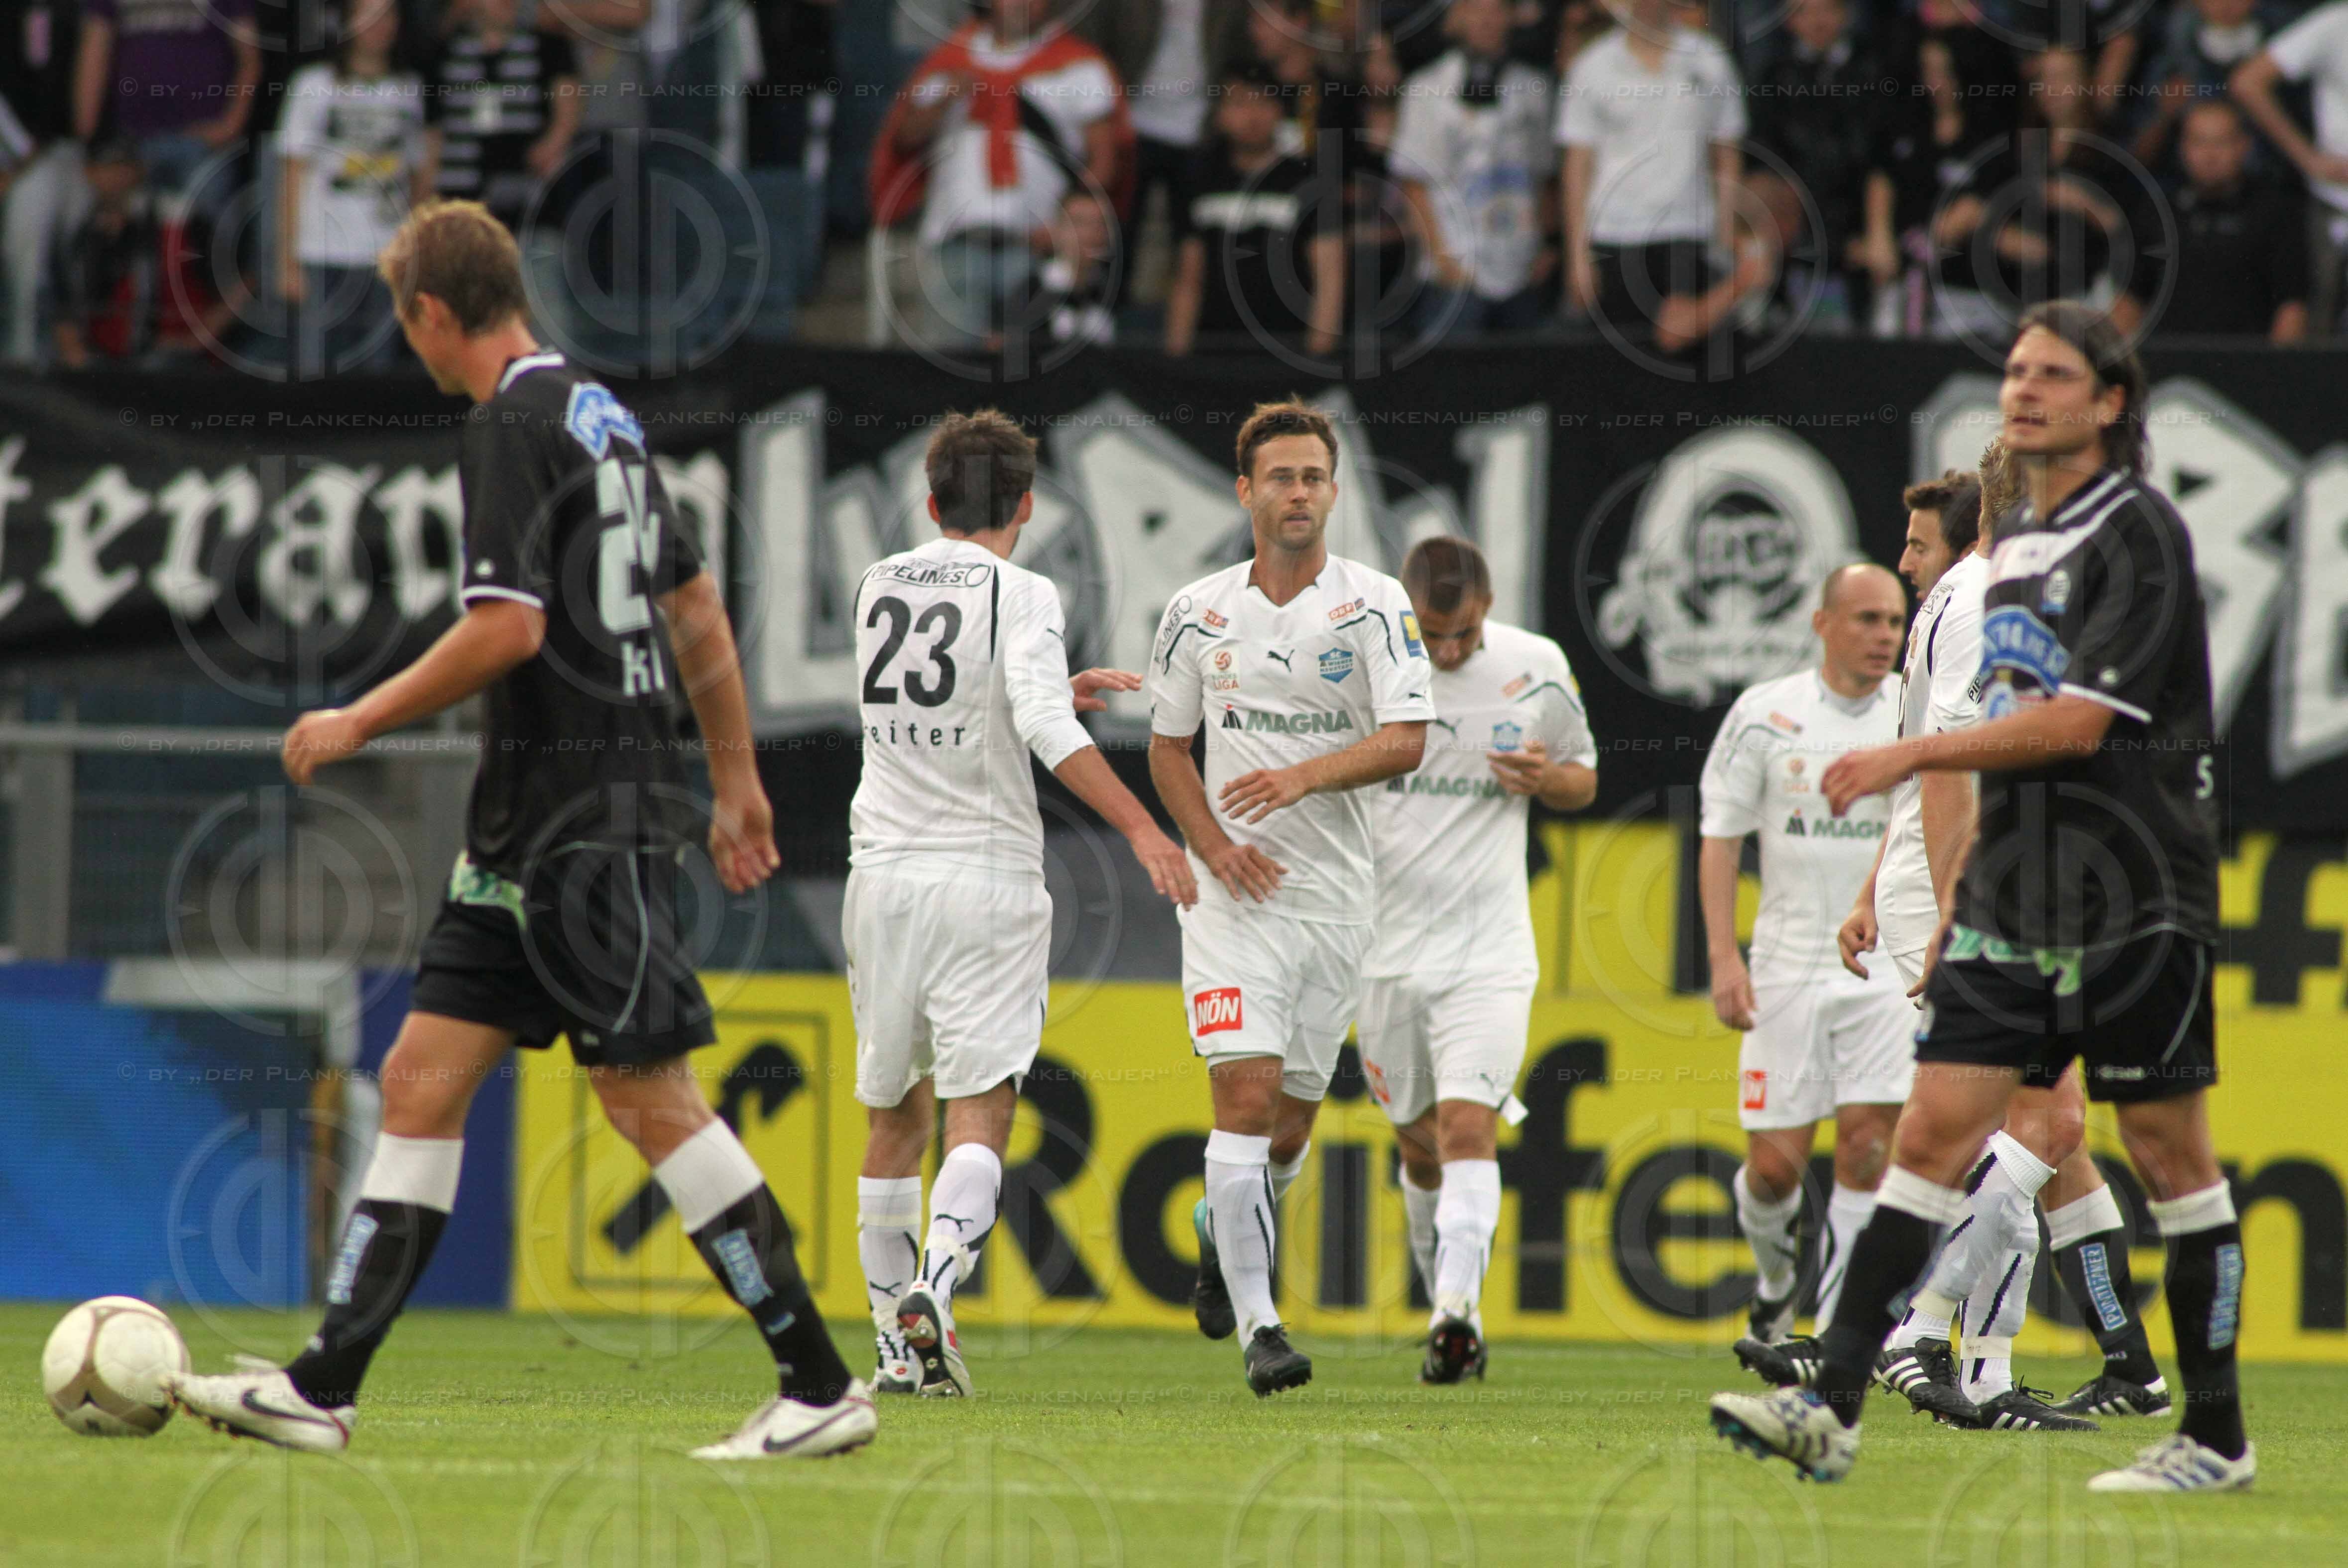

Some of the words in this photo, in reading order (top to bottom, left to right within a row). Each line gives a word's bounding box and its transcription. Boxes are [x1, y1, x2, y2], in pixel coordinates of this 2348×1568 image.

[872, 564, 965, 584] PIPELINES
[1329, 603, 1354, 620] ORF
[863, 596, 963, 707] 23
[1246, 709, 1353, 734] MAGNA
[1196, 991, 1240, 1029] NÖN
